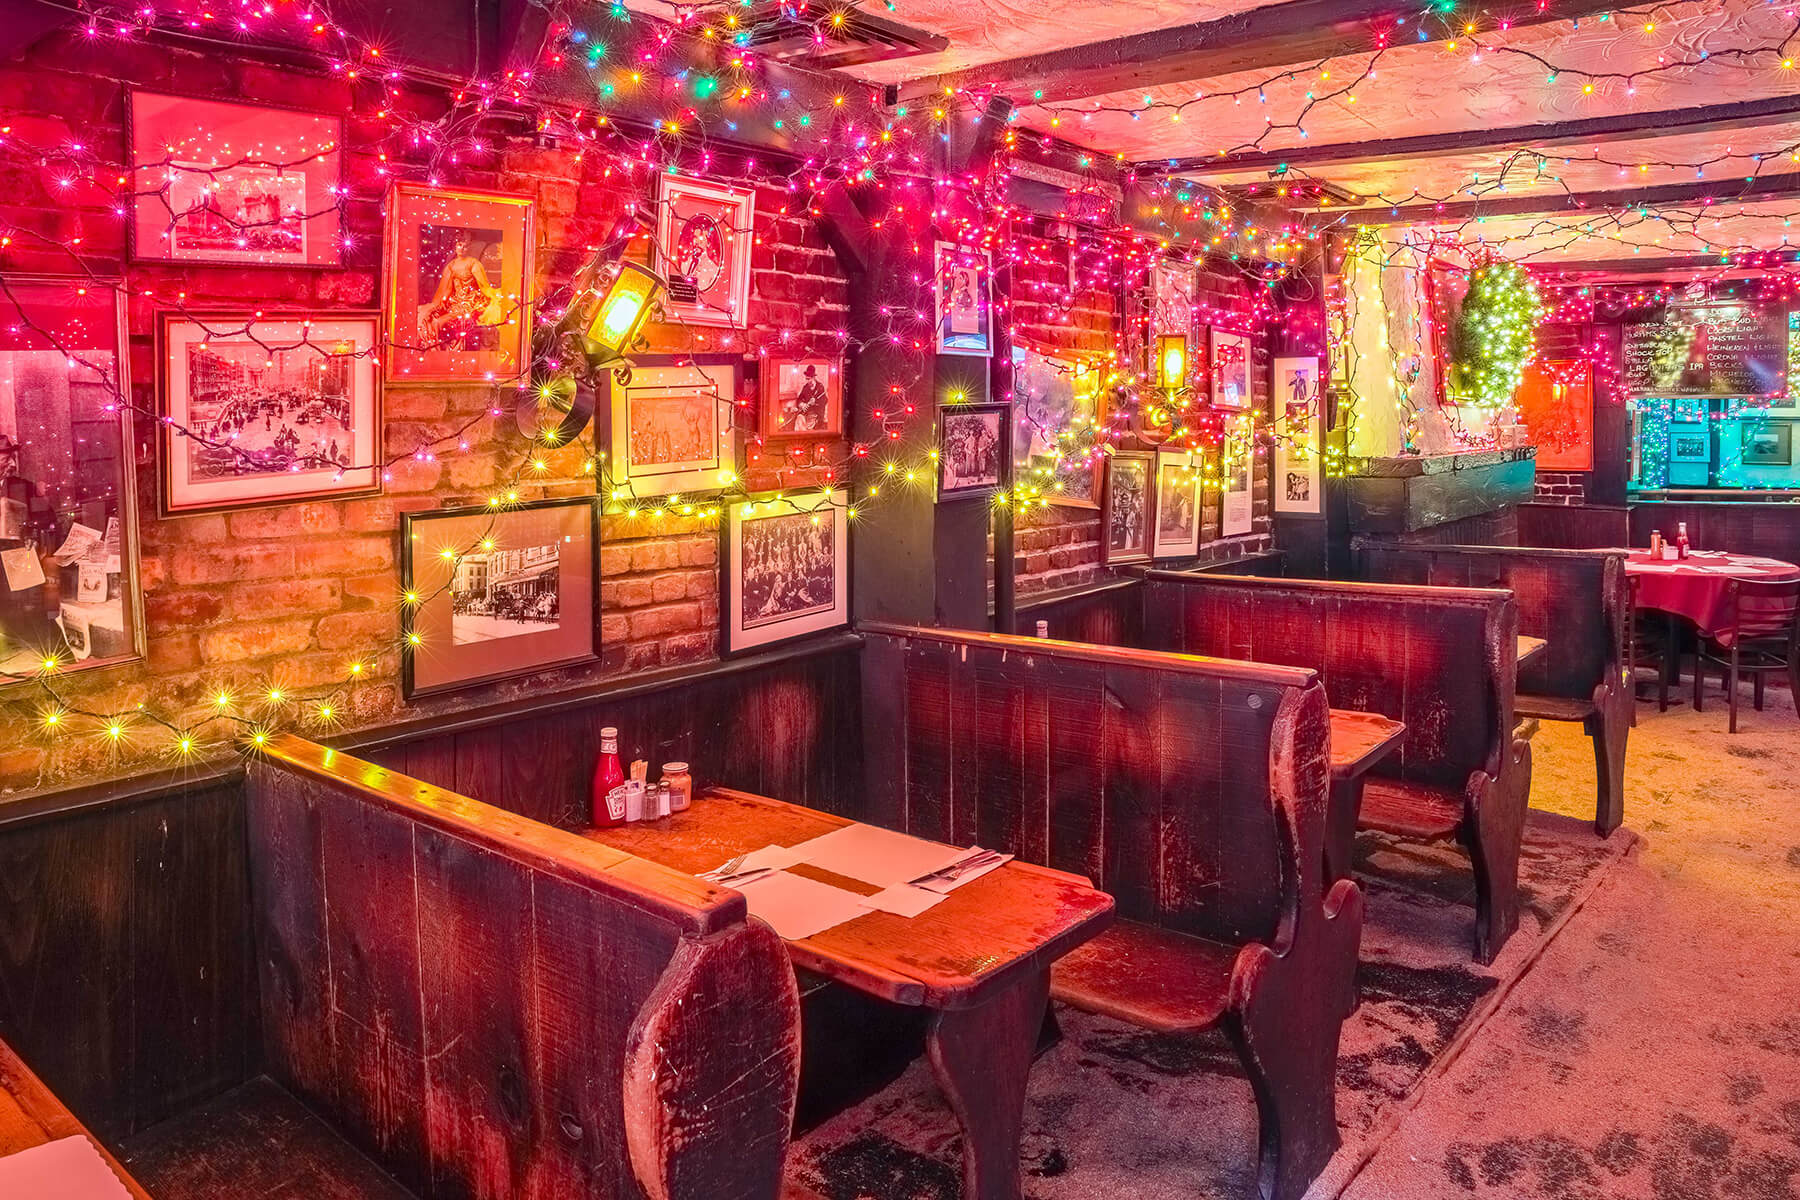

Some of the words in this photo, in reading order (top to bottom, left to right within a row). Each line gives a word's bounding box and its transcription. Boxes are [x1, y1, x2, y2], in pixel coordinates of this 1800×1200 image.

[1706, 326, 1733, 335] COORS
[1707, 334, 1745, 343] AMSTEL
[1706, 343, 1750, 352] HEINEKEN
[1625, 349, 1655, 358] SHOCK
[1706, 353, 1739, 362] CORONA
[1689, 362, 1705, 371] IPA
